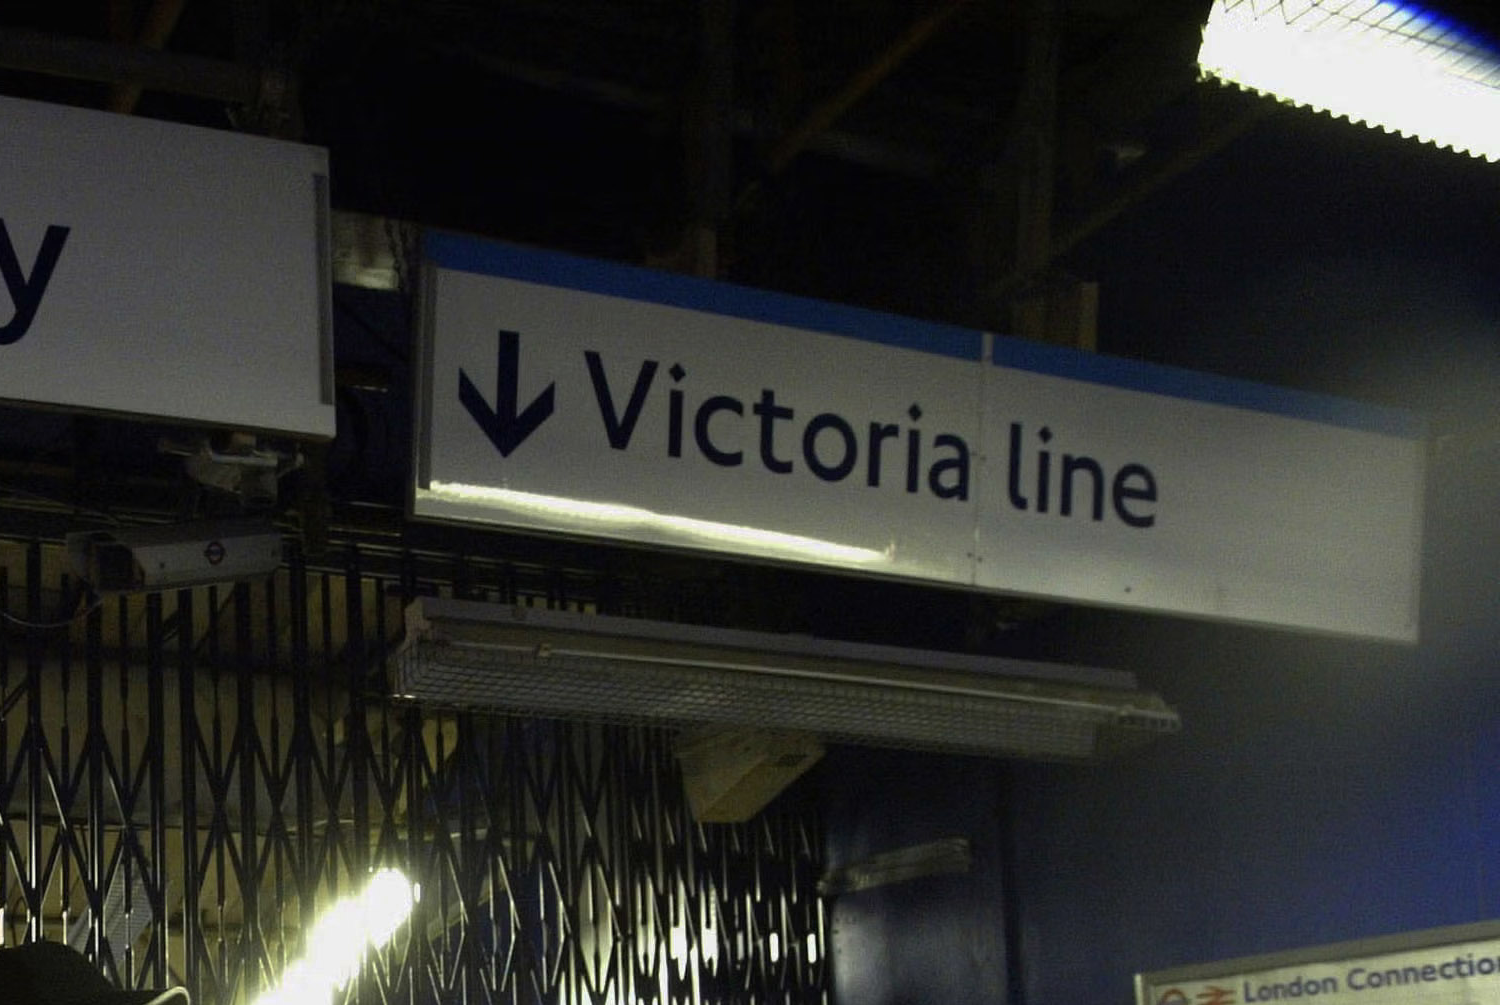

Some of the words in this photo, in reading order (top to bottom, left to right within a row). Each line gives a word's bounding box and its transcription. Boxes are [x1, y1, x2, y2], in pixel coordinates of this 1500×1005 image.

[583, 350, 969, 501] Victoria
[1008, 422, 1157, 528] line
[1243, 976, 1338, 1003] London
[1347, 953, 1500, 990] Connectio
